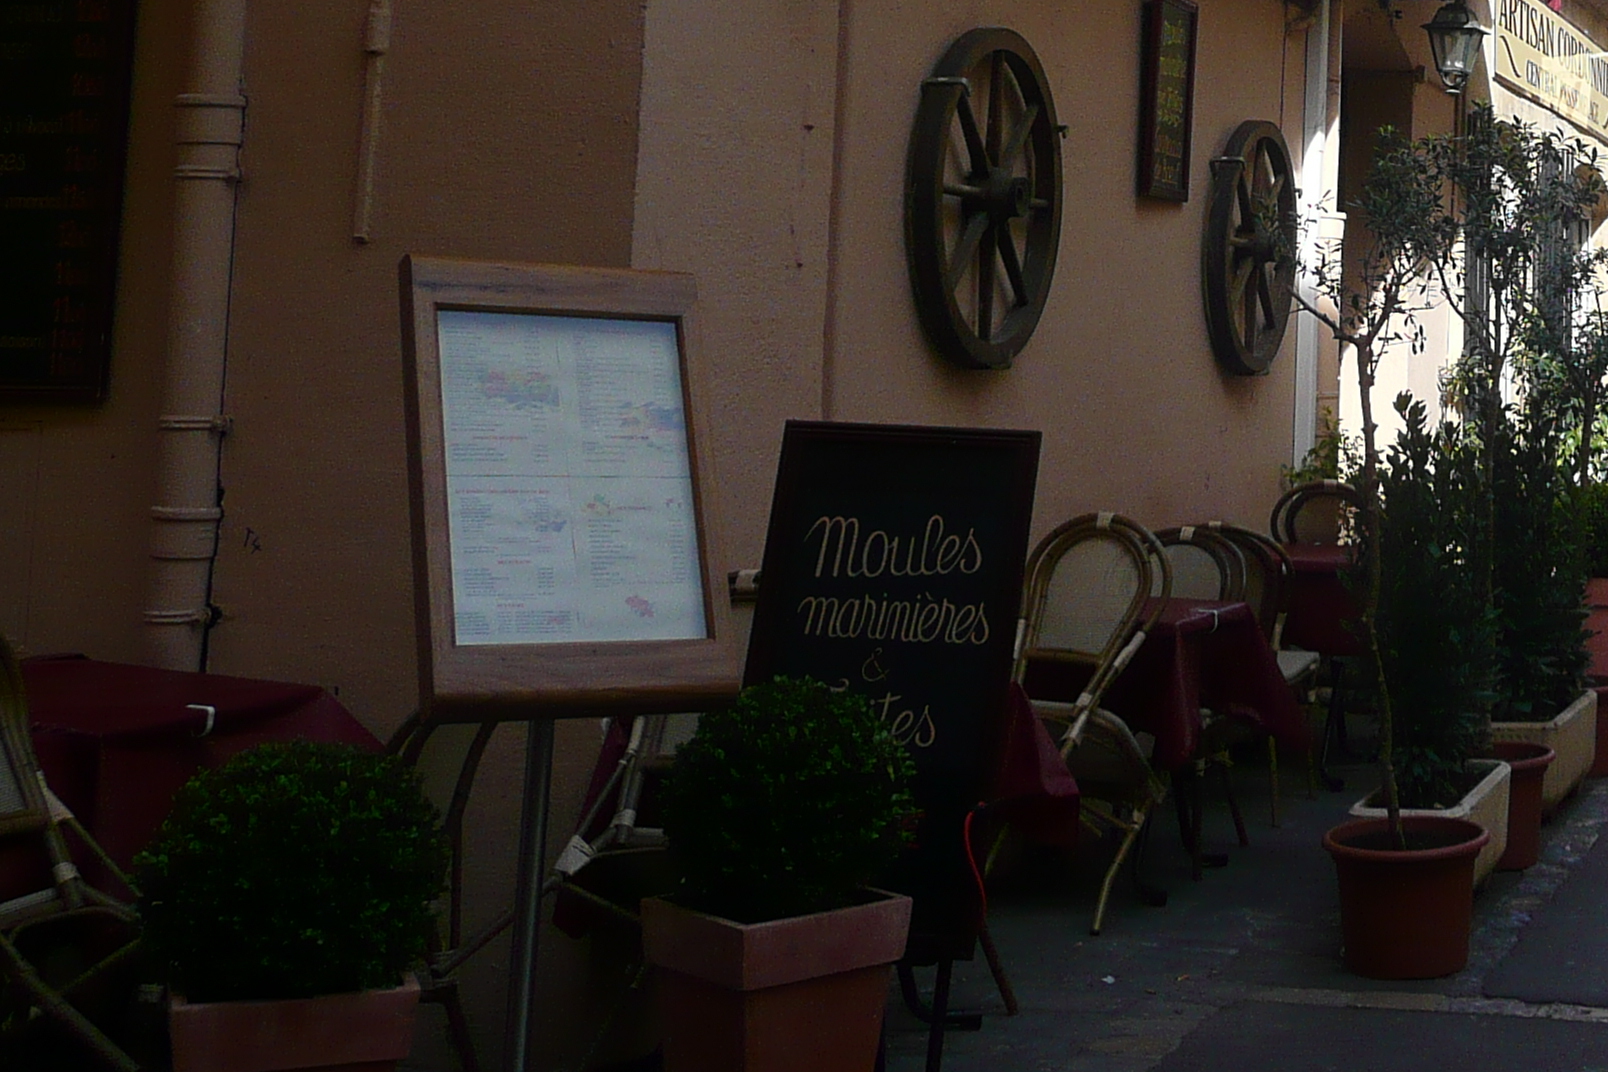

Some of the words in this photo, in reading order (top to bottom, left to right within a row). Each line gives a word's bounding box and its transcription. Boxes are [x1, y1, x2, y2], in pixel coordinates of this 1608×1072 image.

[803, 513, 983, 579] Moules
[797, 591, 991, 646] marinières
[861, 646, 890, 683] &
